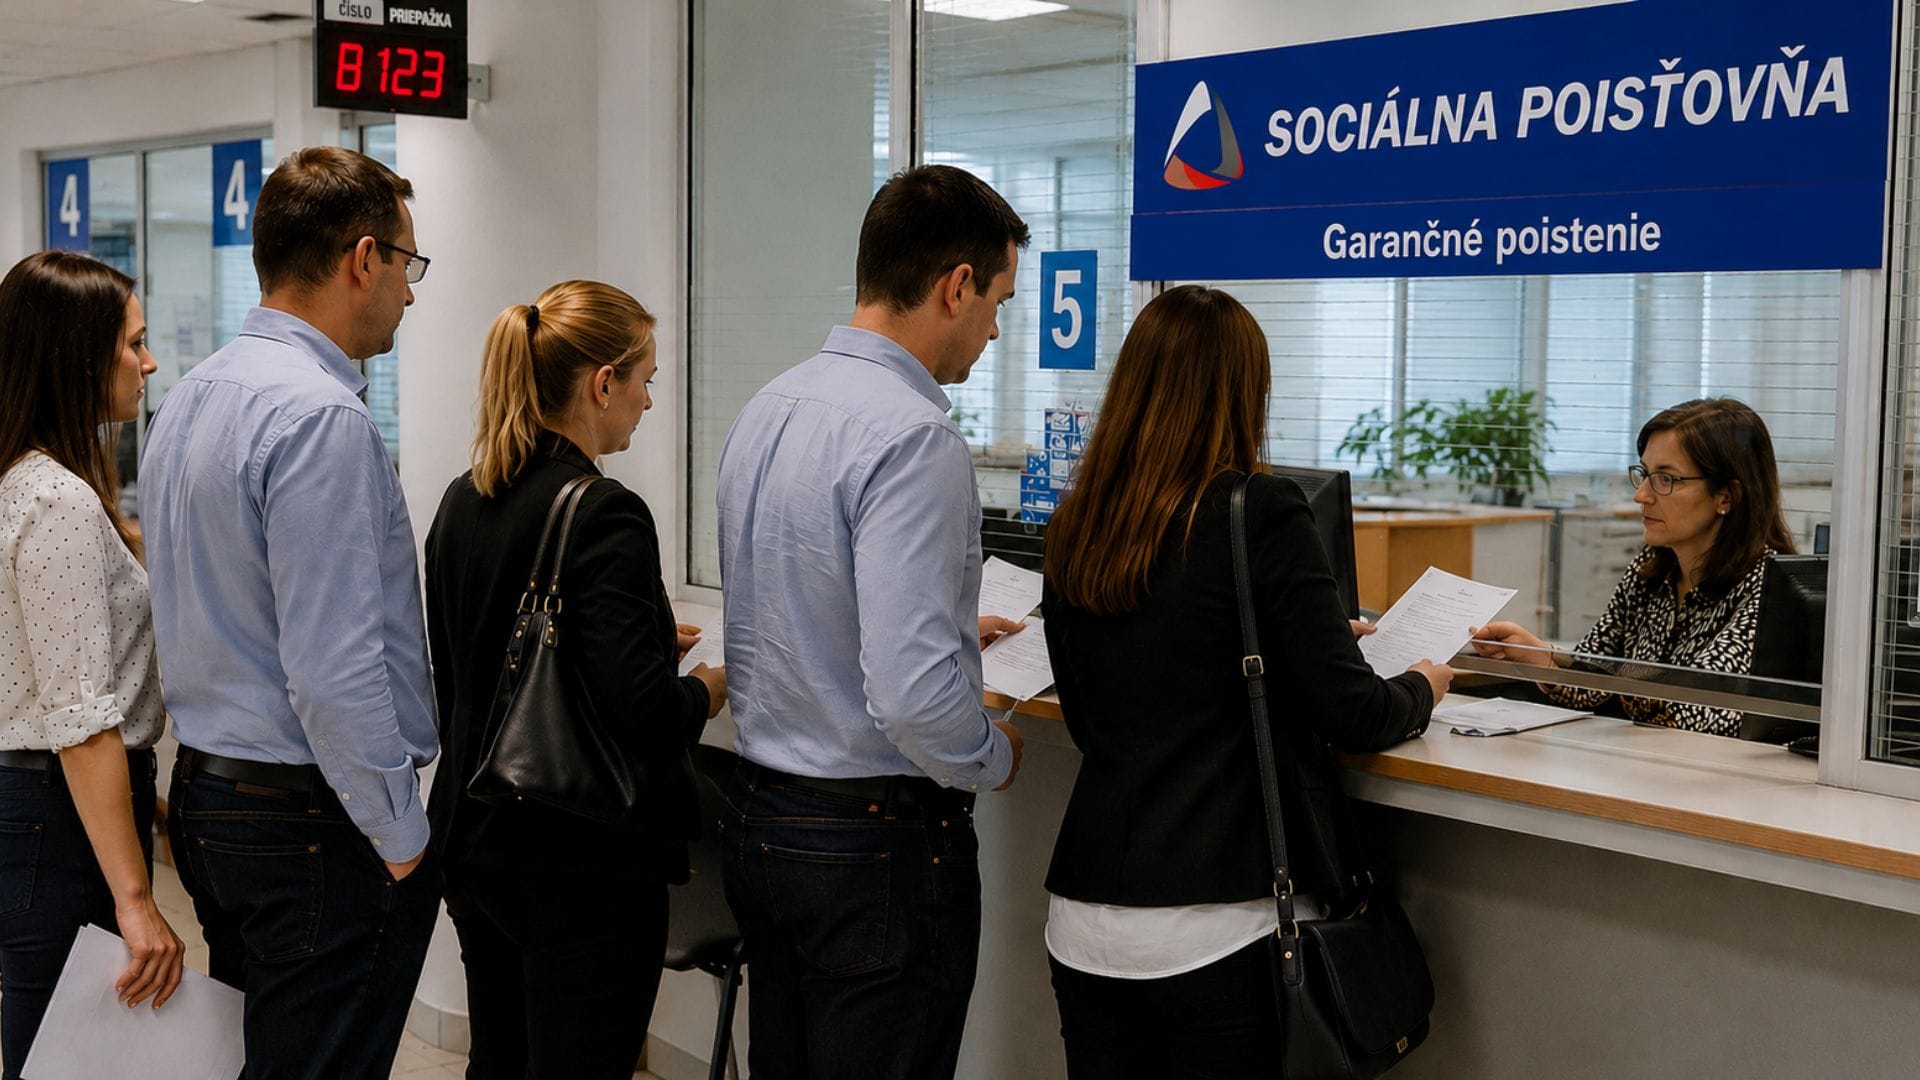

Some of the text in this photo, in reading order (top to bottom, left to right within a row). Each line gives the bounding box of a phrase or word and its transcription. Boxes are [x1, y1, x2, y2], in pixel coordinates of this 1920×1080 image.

[389, 7, 452, 28] PRIEPAŽKA
[1264, 45, 1849, 157] SOCIÁLNA POISŤOVŇA
[60, 175, 81, 237] 4
[223, 160, 249, 230] 4
[1323, 213, 1661, 265] Garančné poistenie
[1051, 269, 1082, 349] 5
